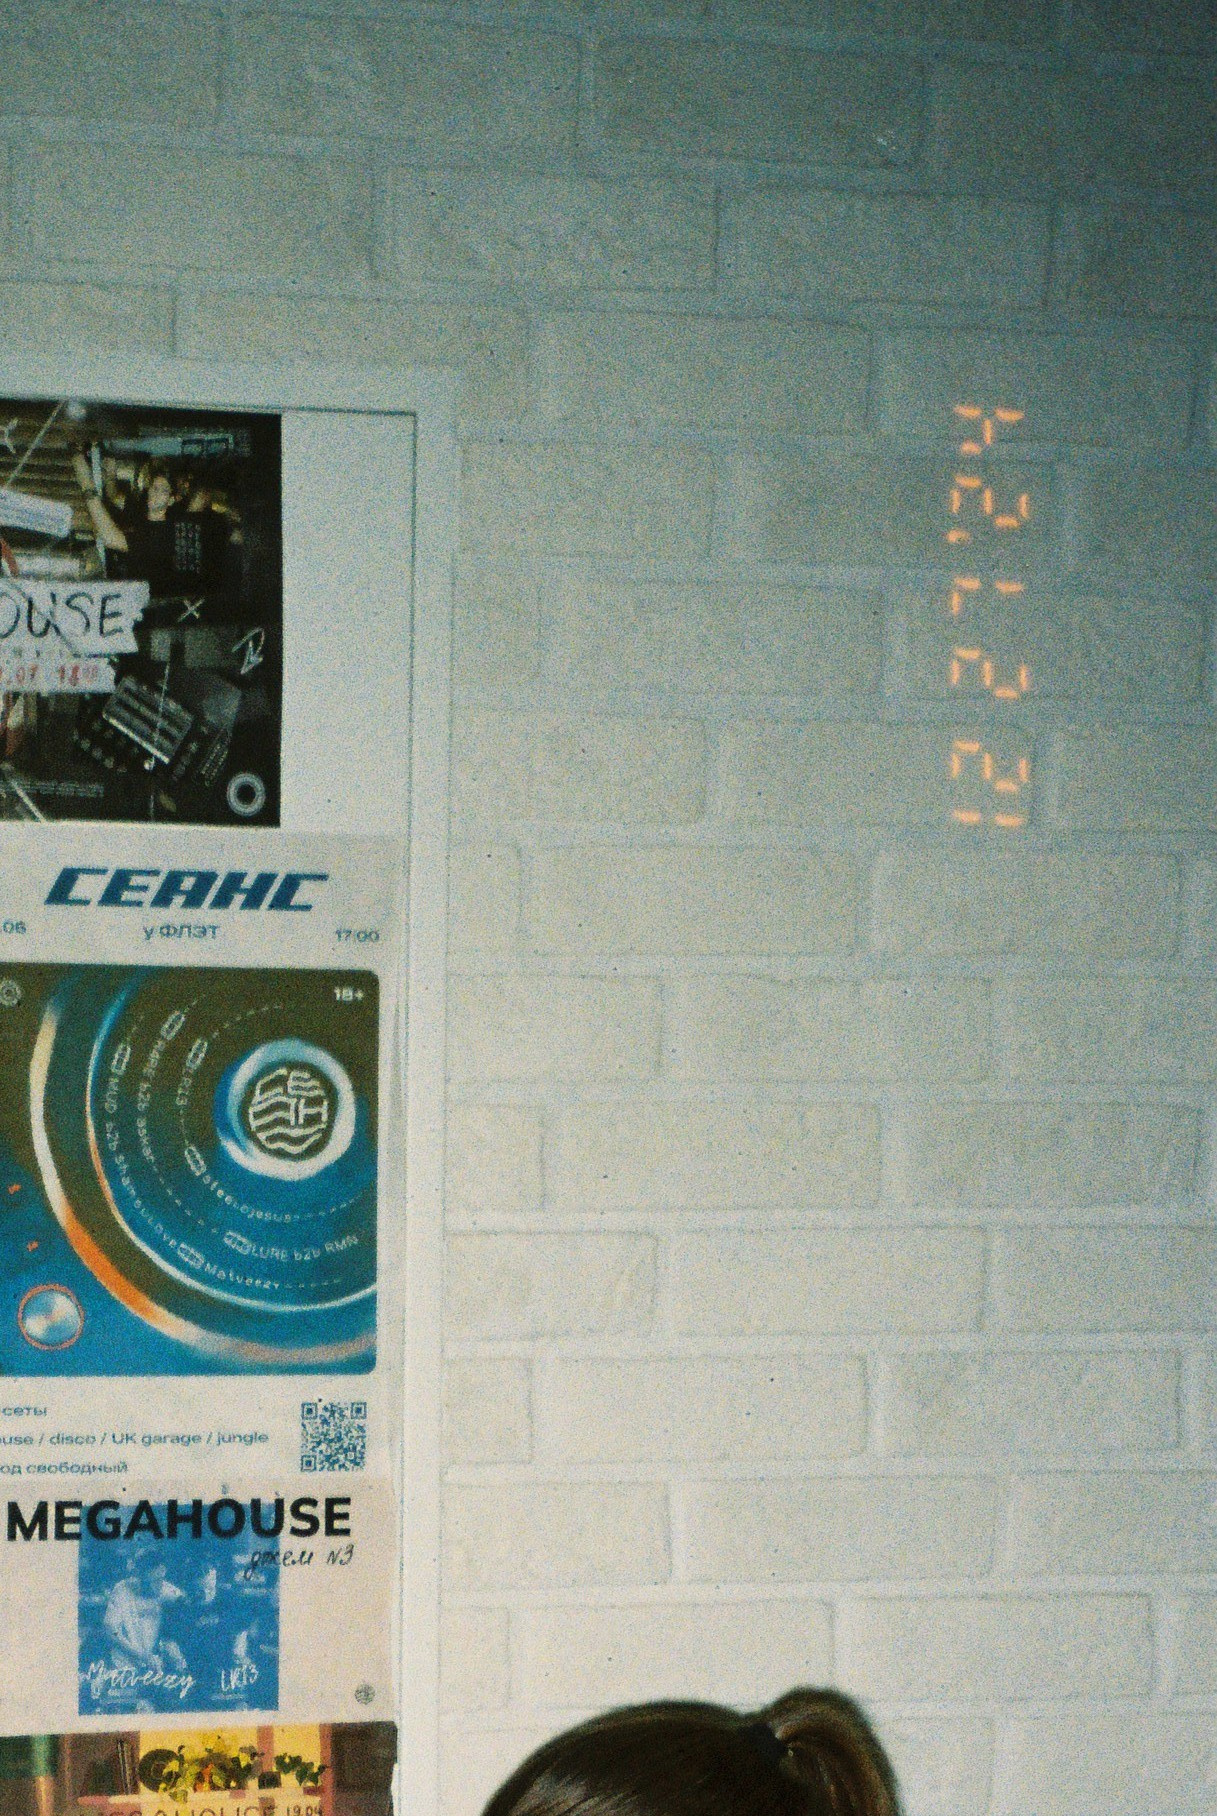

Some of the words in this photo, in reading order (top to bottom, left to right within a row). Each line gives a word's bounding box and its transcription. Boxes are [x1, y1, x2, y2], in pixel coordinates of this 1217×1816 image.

[44, 867, 330, 912] СЕАНС
[159, 923, 221, 940] ФЛЭТ
[49, 1432, 96, 1446] disco
[111, 1431, 137, 1445] UK
[141, 1433, 202, 1449] garage
[216, 1430, 269, 1448] jungle
[25, 1461, 129, 1477] свободный
[6, 1496, 352, 1543] MEGAHOUSE
